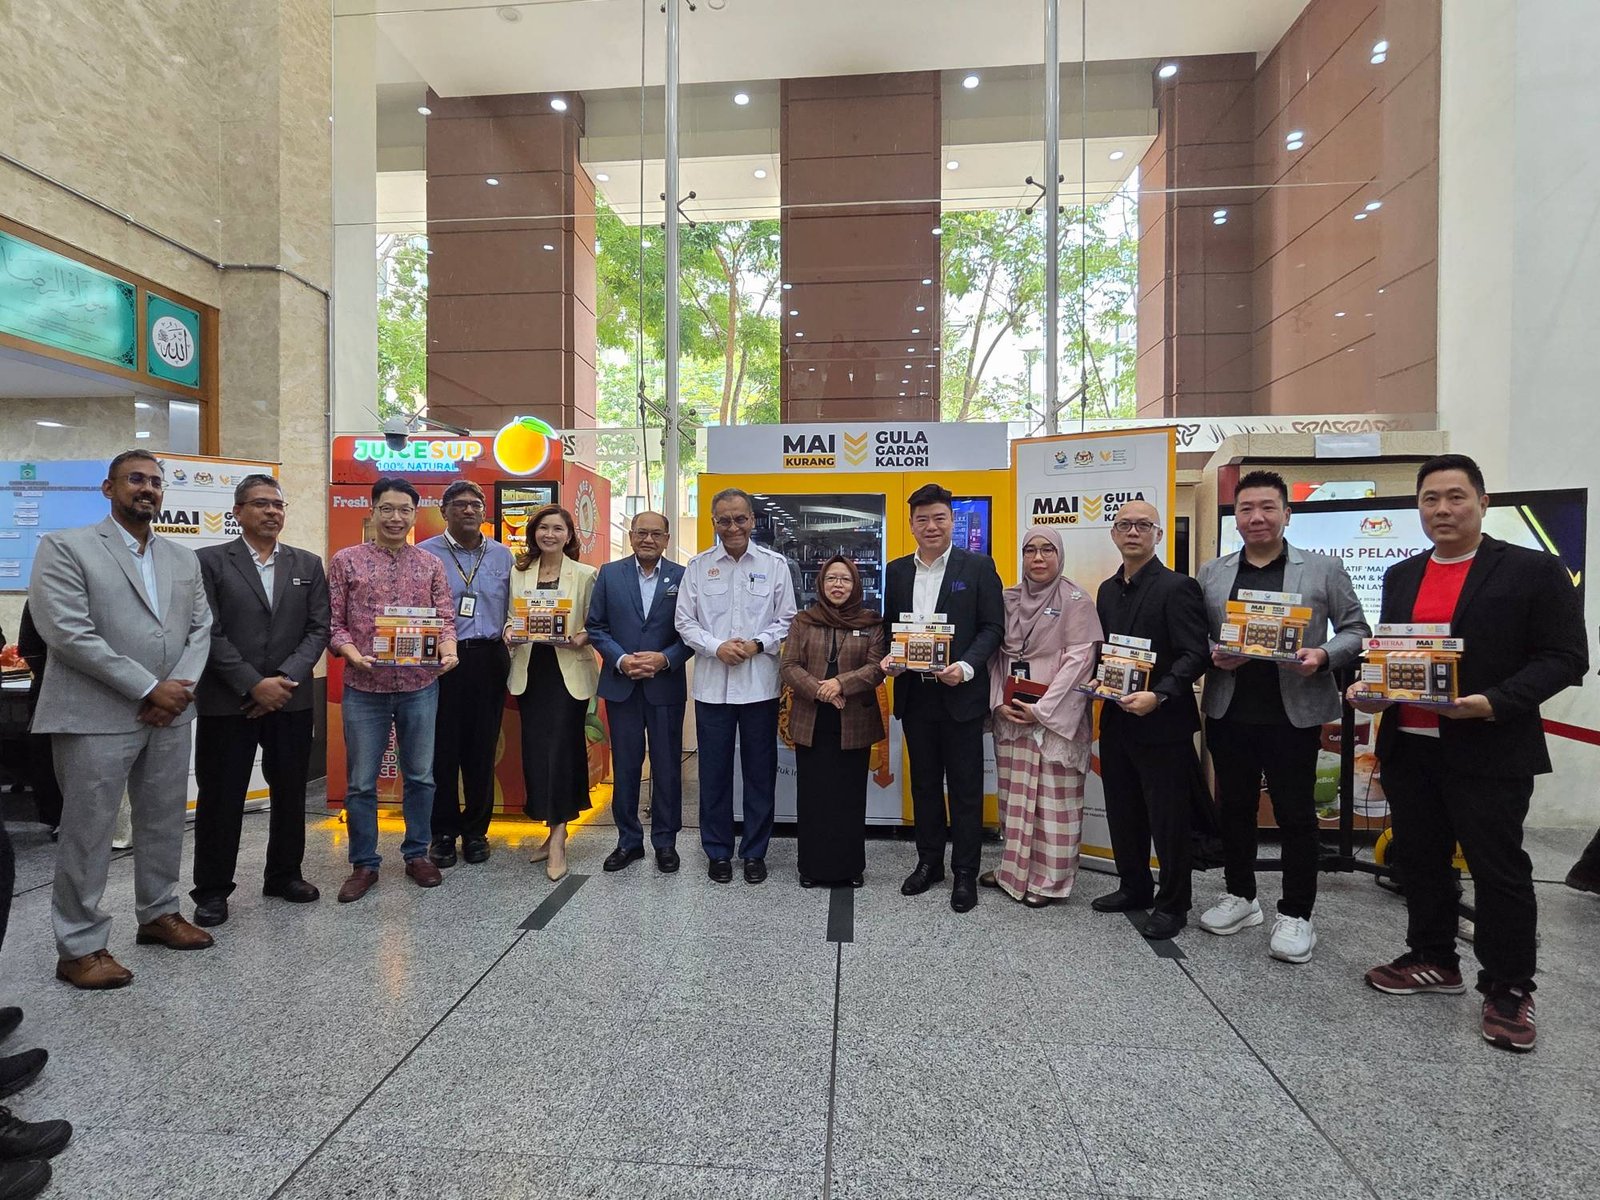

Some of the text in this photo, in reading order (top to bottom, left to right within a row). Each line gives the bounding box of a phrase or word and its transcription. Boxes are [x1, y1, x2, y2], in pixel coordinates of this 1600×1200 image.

[875, 430, 928, 444] GULA
[783, 434, 835, 453] MAI
[875, 445, 929, 456] GARAM
[377, 462, 457, 471] 100% NATURAL
[786, 457, 835, 466] KURANG
[875, 456, 929, 467] KALORI
[333, 495, 369, 508] Fresh
[1104, 492, 1145, 503] GULA
[1032, 496, 1079, 515] MAI
[153, 510, 200, 525] MAI
[1033, 516, 1077, 525] KURANG
[153, 526, 199, 534] KURANG
[1358, 547, 1429, 558] PELANC
